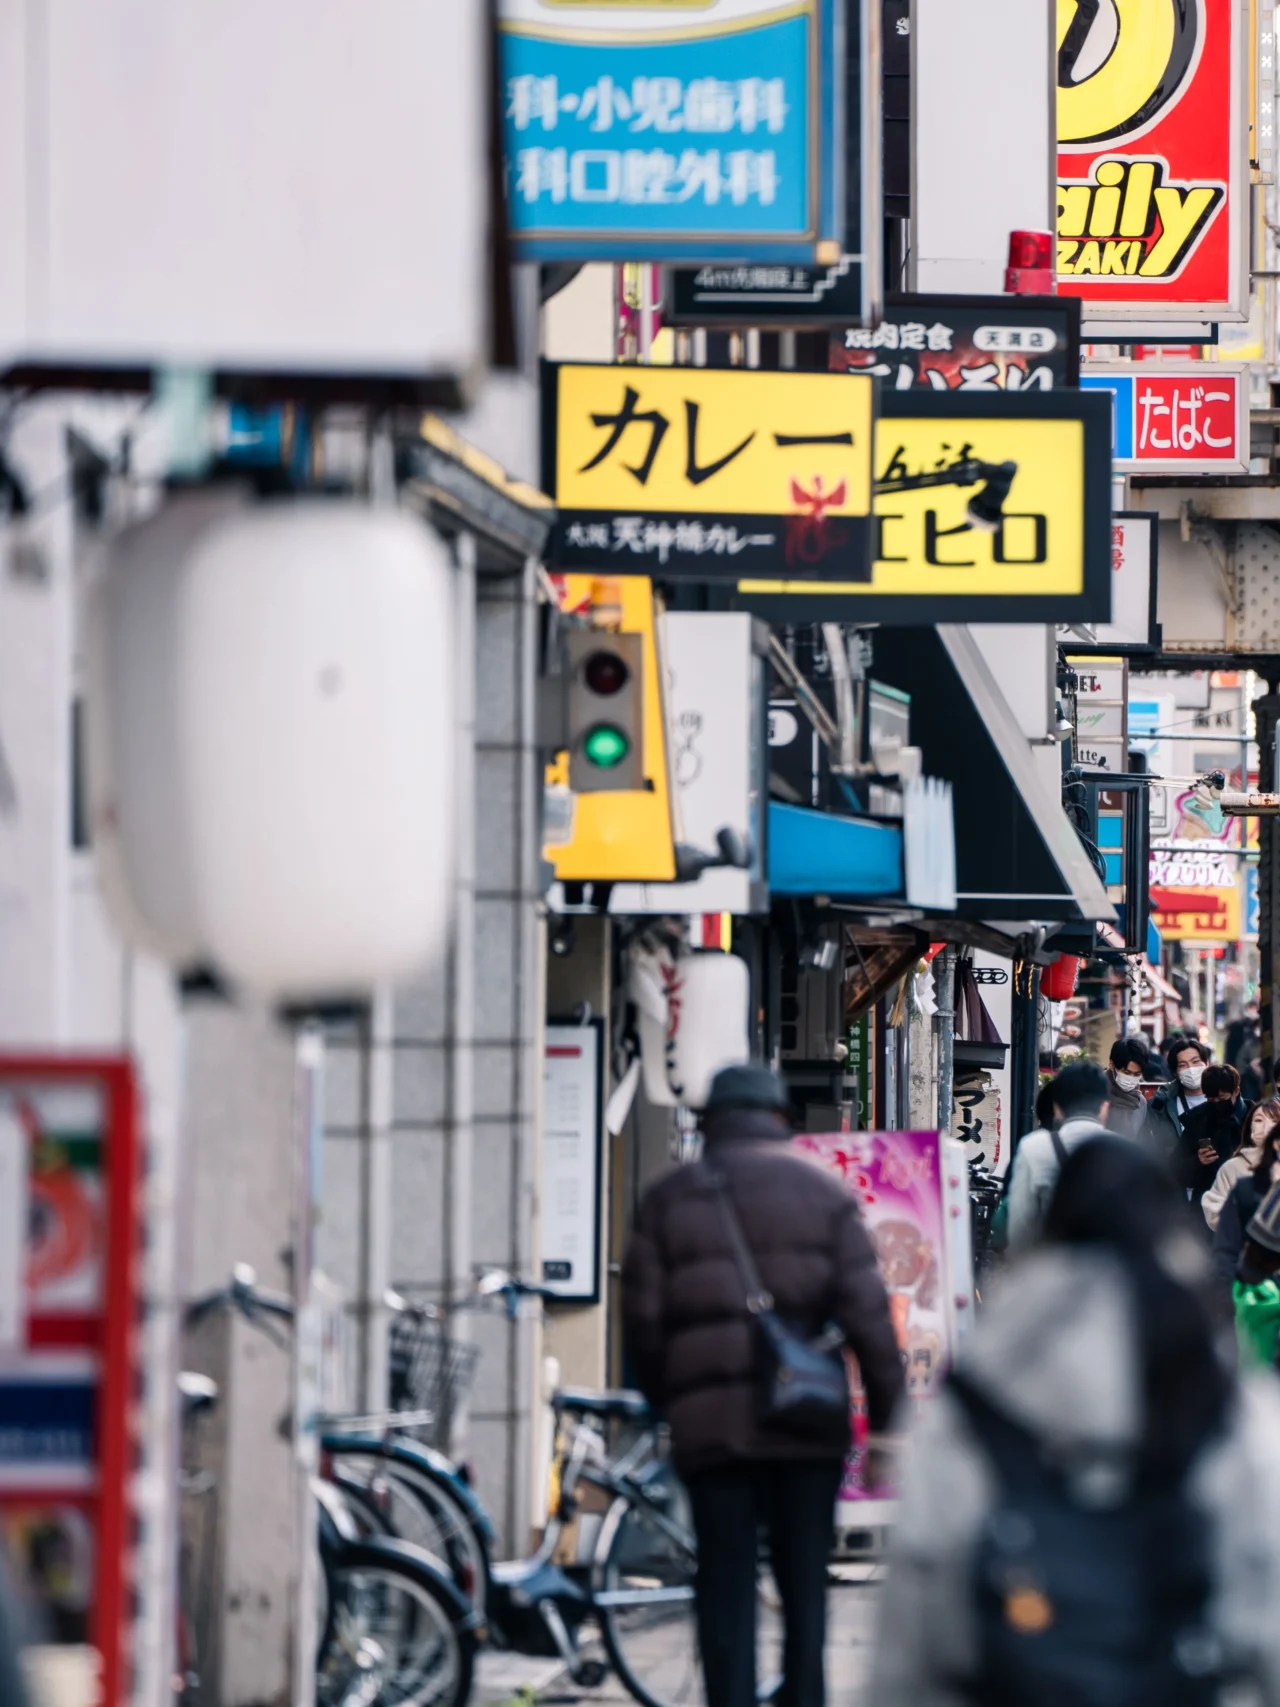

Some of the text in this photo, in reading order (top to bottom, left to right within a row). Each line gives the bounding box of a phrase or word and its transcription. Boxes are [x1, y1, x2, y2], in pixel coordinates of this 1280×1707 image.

[576, 384, 855, 486] カレー
[1138, 385, 1233, 450] たばこ
[1075, 675, 1098, 692] ET
